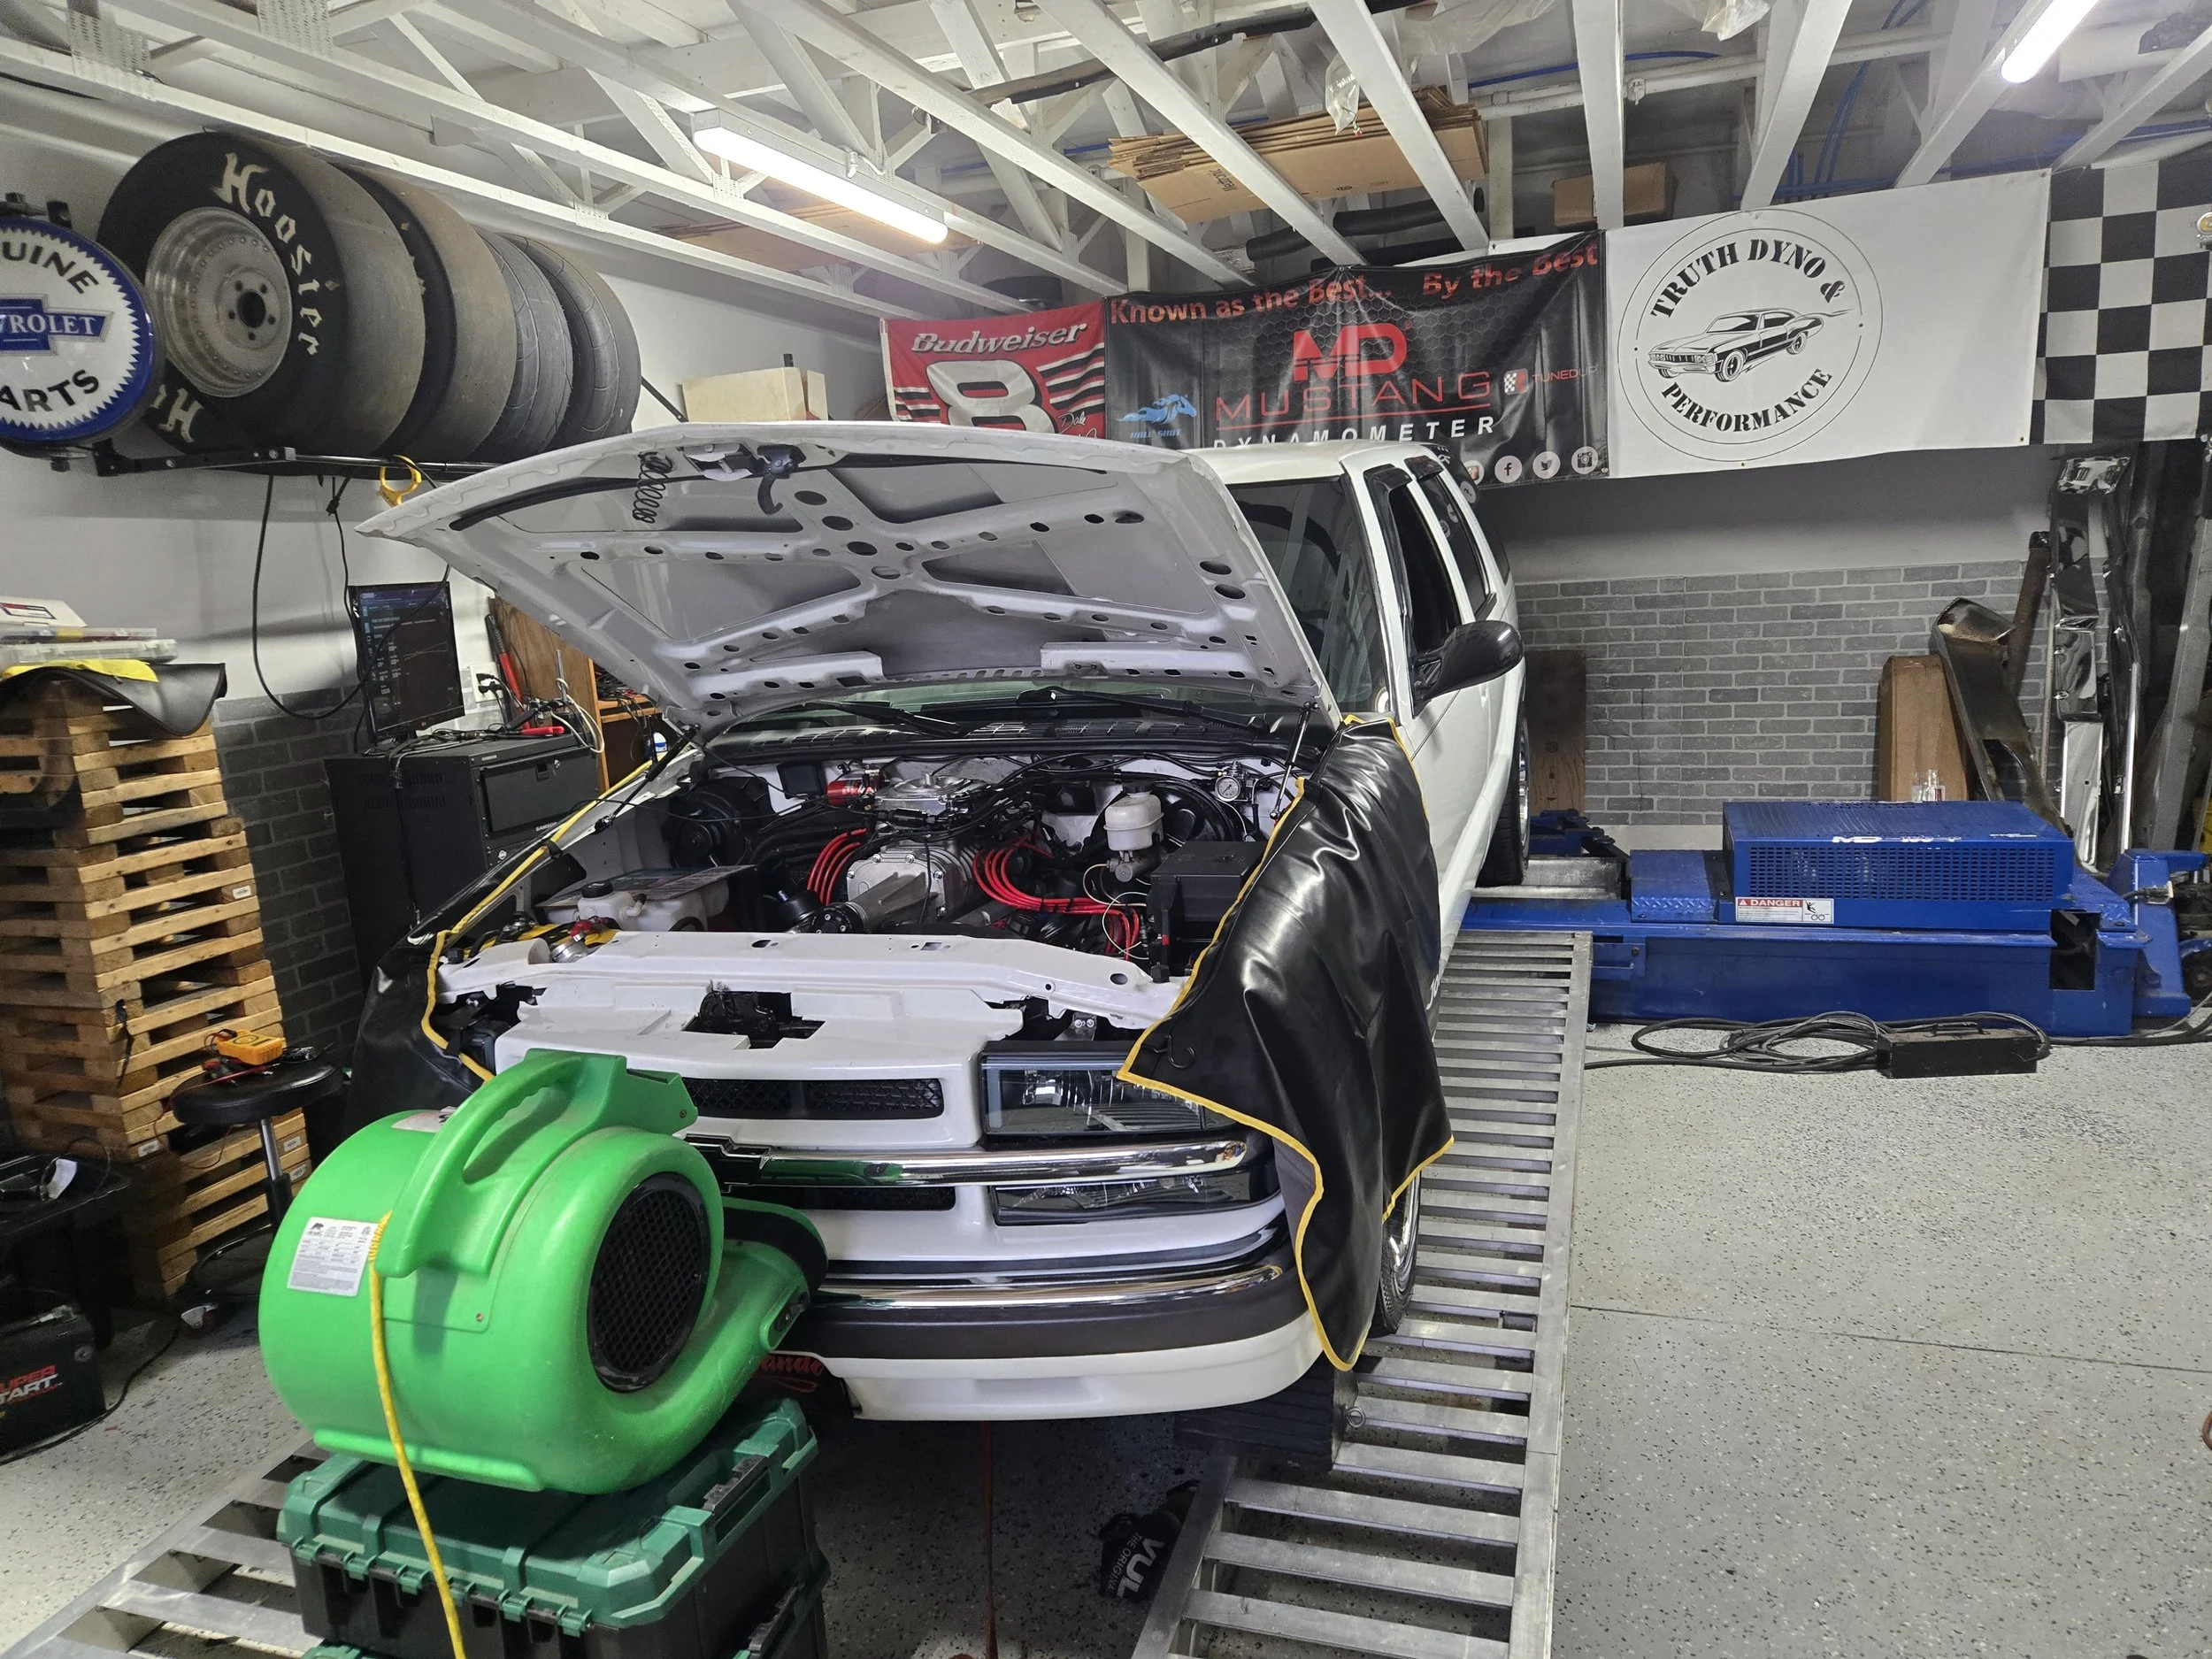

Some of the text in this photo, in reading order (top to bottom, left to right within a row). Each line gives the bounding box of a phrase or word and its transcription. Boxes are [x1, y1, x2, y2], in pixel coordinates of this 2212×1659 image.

[2, 242, 99, 294] UINE
[211, 152, 322, 355] Hoosier
[1650, 239, 1846, 318] TRUTH DYNO &
[1110, 298, 1207, 325] Known
[1216, 298, 1245, 319] as
[1252, 286, 1299, 312] the
[1423, 272, 1460, 300] By
[1471, 265, 1523, 289] the
[1532, 244, 1599, 277] Best
[0, 313, 96, 335] ROLET
[911, 322, 1087, 354] Budweiser
[1293, 322, 1408, 382] MD
[0, 369, 99, 411] ARTS
[926, 359, 1058, 434] 8
[1216, 372, 1491, 421] MUSTANG
[1661, 368, 1833, 433] PERFORMANCE
[0, 1364, 57, 1394] UPER
[0, 1373, 59, 1405] TART
[1107, 1532, 1143, 1592] THE ORIGINA
